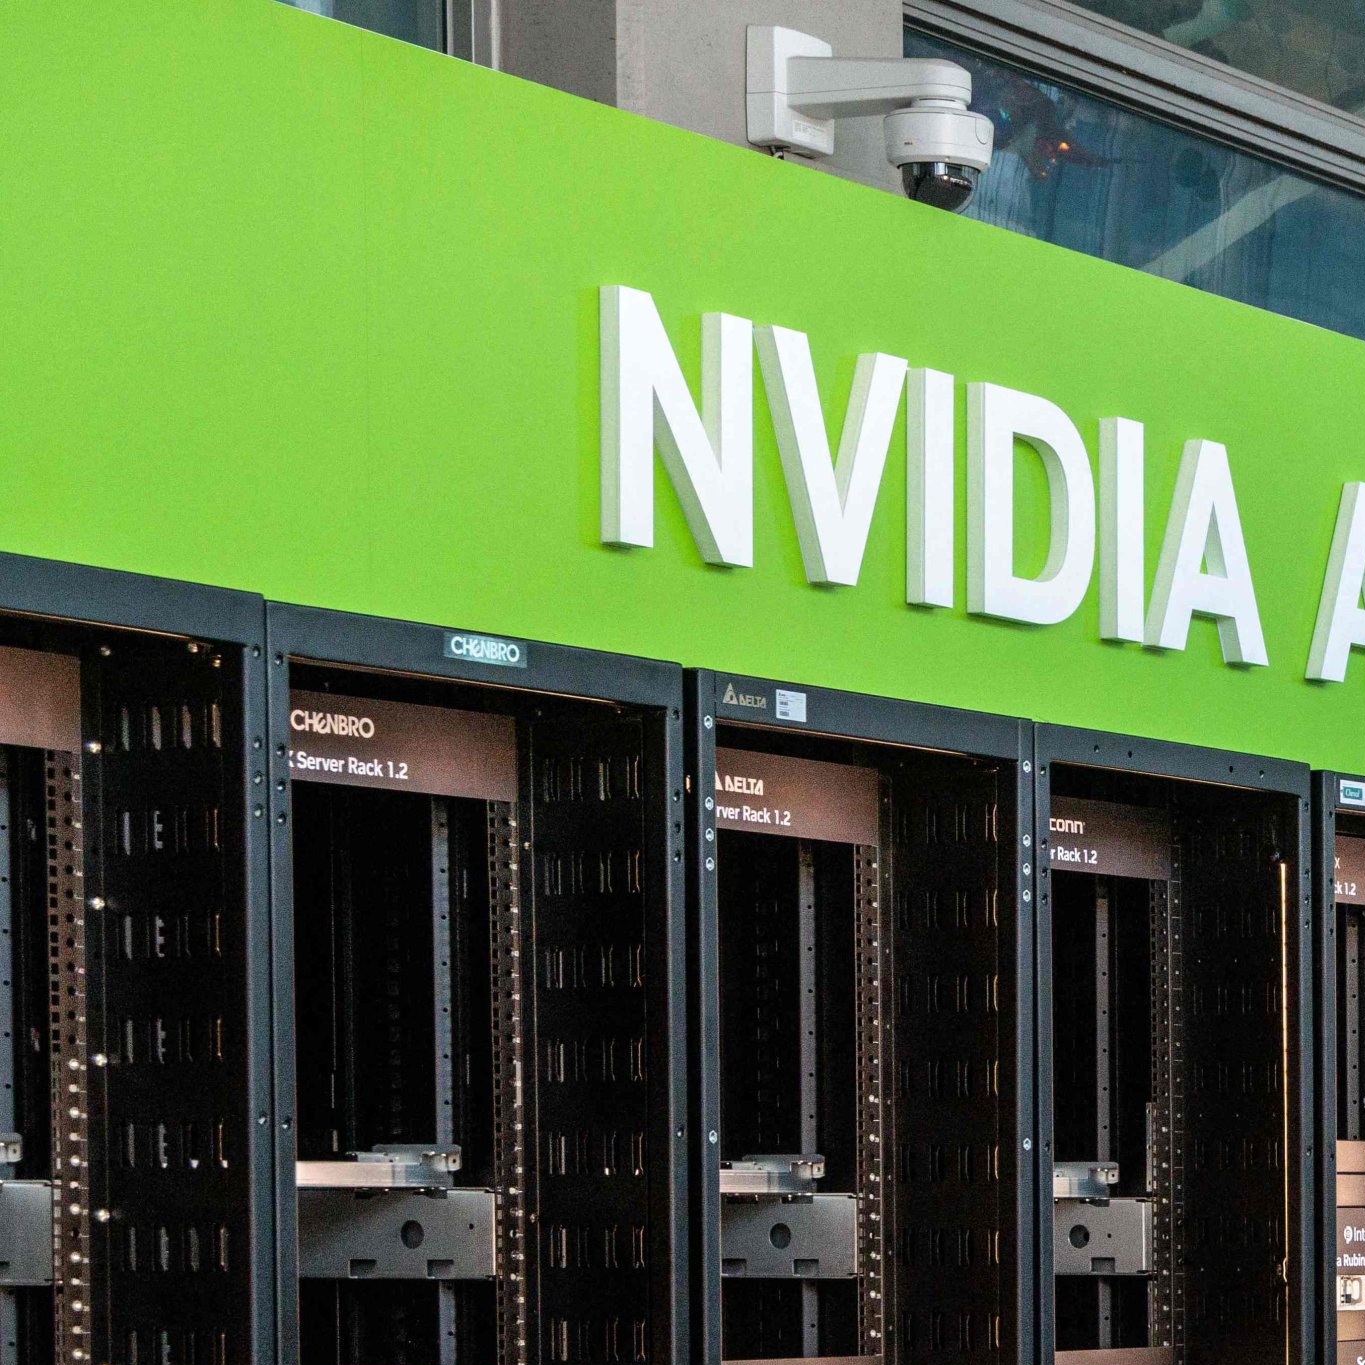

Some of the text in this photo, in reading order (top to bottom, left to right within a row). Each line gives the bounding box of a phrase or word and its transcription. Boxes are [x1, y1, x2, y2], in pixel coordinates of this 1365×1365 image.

[600, 284, 1269, 667] NVIDIA
[451, 636, 520, 663] CHENBRO
[290, 709, 375, 738] CHENBRO
[296, 751, 345, 773] Server
[348, 756, 383, 777] Rack
[386, 760, 408, 780] 1.2
[716, 805, 791, 826] rver Rack 1.2
[1057, 846, 1081, 863] Rack
[1083, 849, 1098, 864] 1.2
[1344, 882, 1357, 896] 1.2
[1343, 1254, 1365, 1267] Rubin
